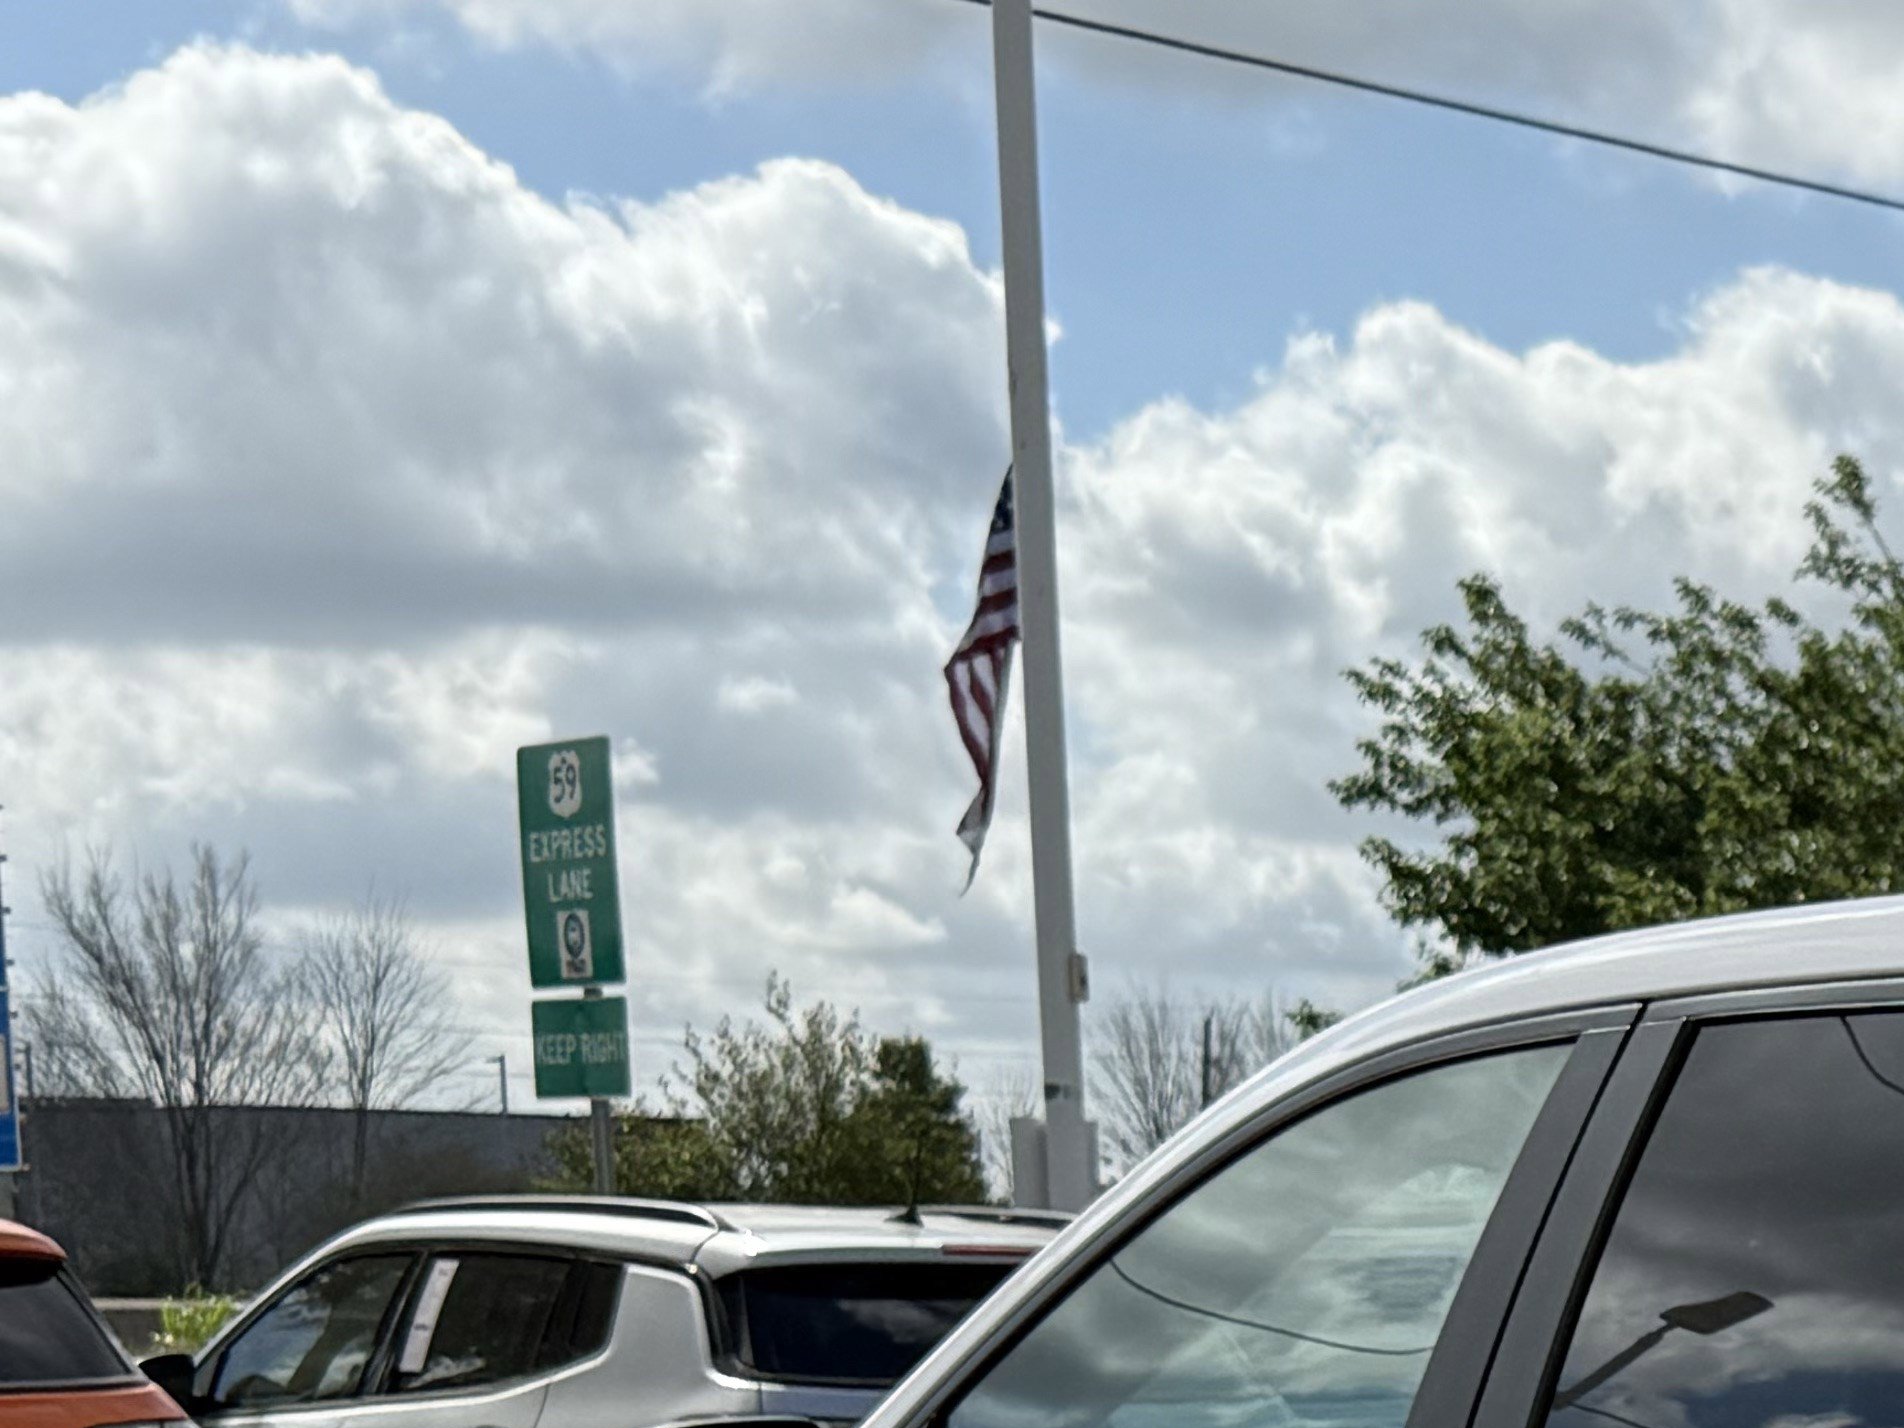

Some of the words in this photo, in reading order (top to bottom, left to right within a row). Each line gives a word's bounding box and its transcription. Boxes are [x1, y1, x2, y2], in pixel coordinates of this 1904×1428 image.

[553, 763, 577, 804] 59
[529, 823, 607, 863] EXPRESS
[547, 868, 594, 903] LANE
[536, 1032, 577, 1065] KEEP
[580, 1031, 625, 1064] RIGHT
